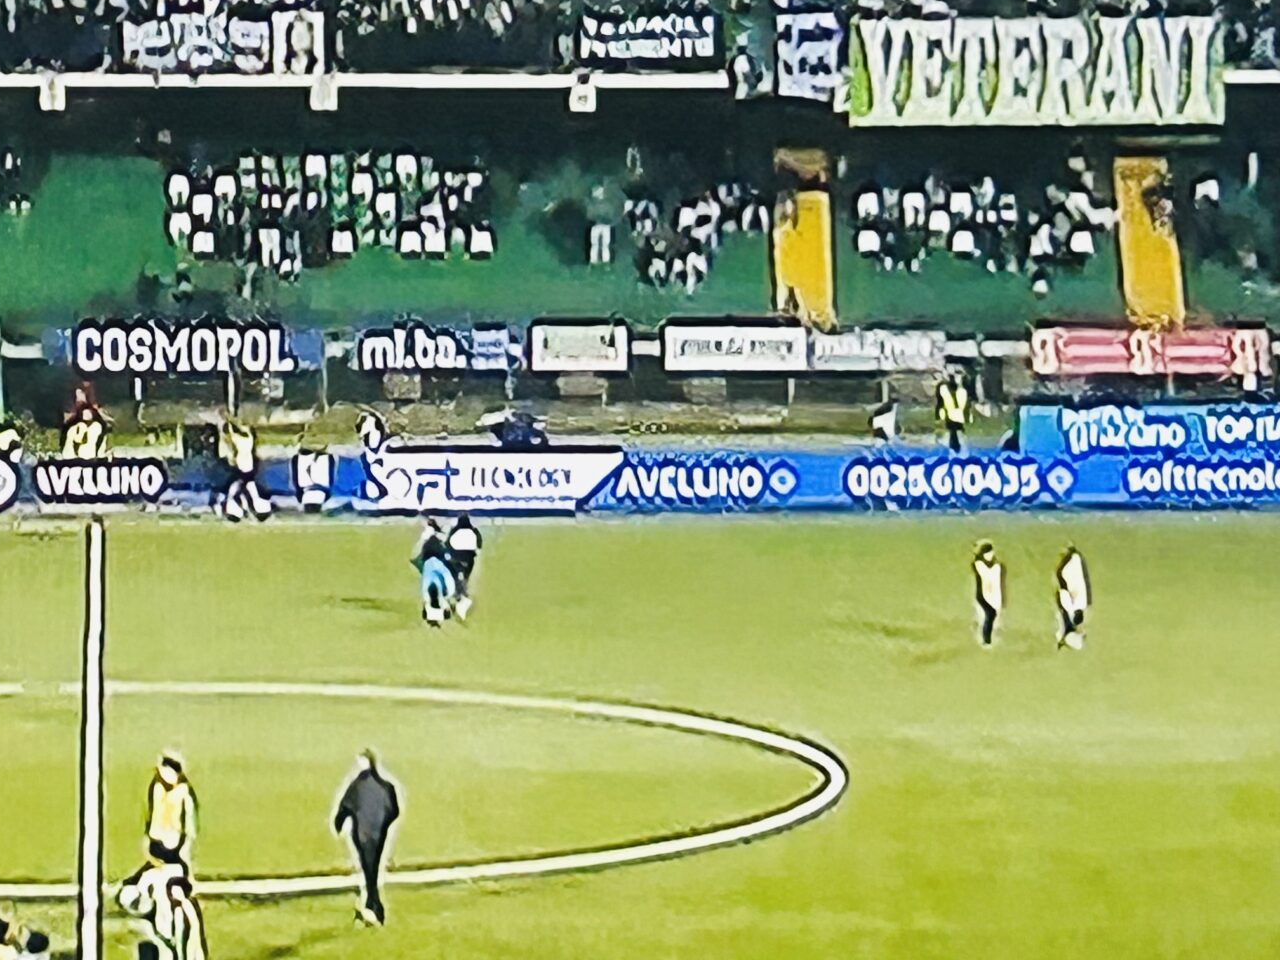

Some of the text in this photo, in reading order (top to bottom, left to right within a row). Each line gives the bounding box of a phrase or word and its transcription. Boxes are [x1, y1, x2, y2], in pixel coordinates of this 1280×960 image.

[859, 16, 1218, 124] VETERANI
[76, 326, 295, 372] COSMOPOL
[615, 464, 763, 500] AVELLINO
